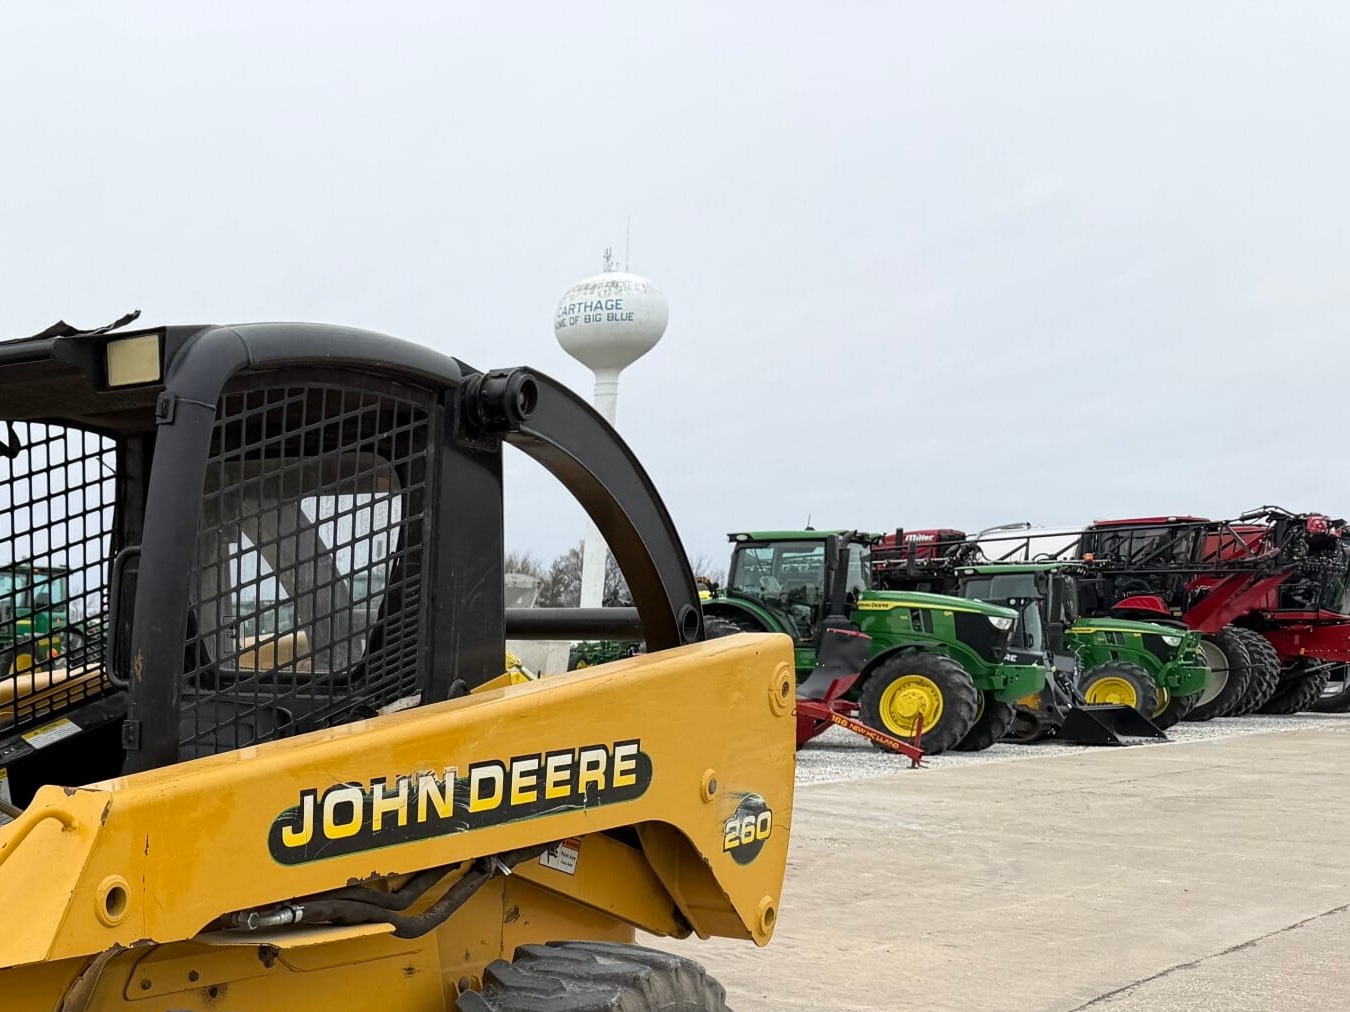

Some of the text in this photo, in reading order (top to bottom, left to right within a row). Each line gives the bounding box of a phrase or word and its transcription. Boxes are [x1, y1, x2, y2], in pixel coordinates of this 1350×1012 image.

[569, 315, 580, 326] OF
[584, 313, 602, 324] BIG
[606, 312, 634, 322] BLUE
[904, 533, 935, 542] Miller
[849, 723, 867, 735] NEW
[281, 744, 638, 847] JOHN DEERE
[723, 808, 773, 851] 260
